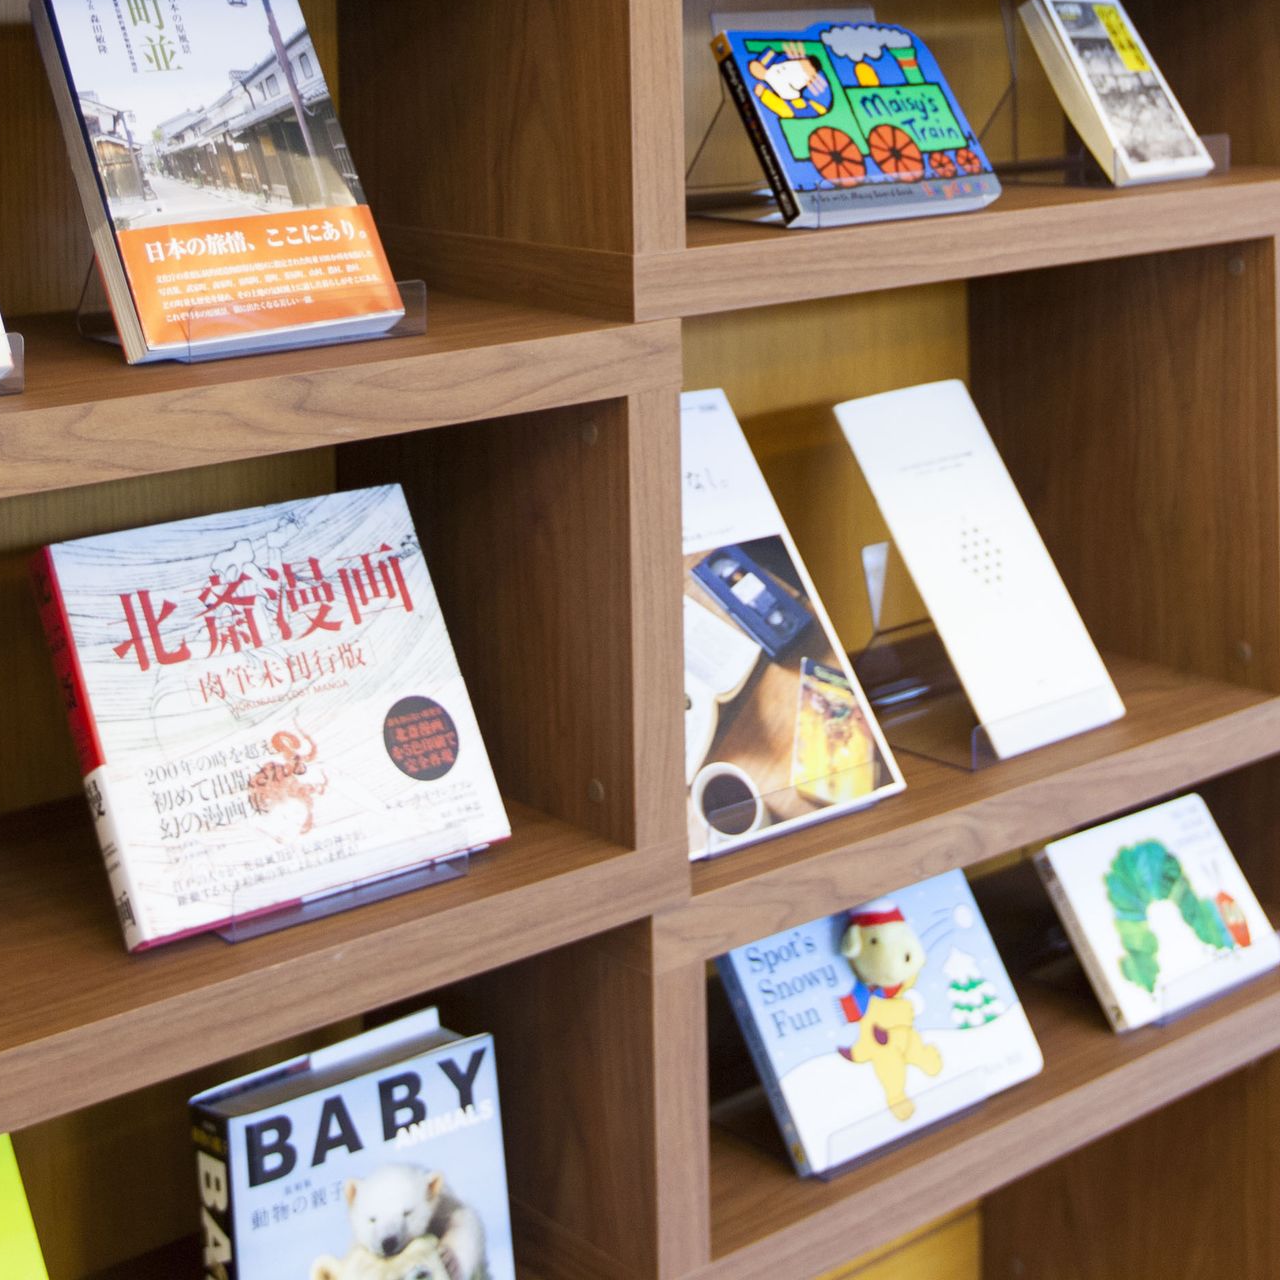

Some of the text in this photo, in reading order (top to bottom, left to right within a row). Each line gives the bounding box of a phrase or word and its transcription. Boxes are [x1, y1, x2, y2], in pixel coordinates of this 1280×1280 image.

[859, 91, 942, 120] Maisy's
[901, 120, 961, 145] Train
[144, 217, 367, 263] 日本の旅情、ここにあり。
[111, 543, 415, 672] 北斎漫画
[198, 644, 368, 704] 肉筆未刊行版
[313, 678, 350, 695] MANGA
[151, 752, 308, 815] 初めて出版される
[158, 791, 272, 841] 幻の漫画集
[745, 929, 818, 974] Spot's
[757, 962, 841, 1008] Snowy
[770, 1006, 822, 1038] Fun
[244, 1046, 487, 1188] BABY
[394, 1098, 495, 1151] ANIMALS
[250, 1179, 343, 1232] 動物の親子
